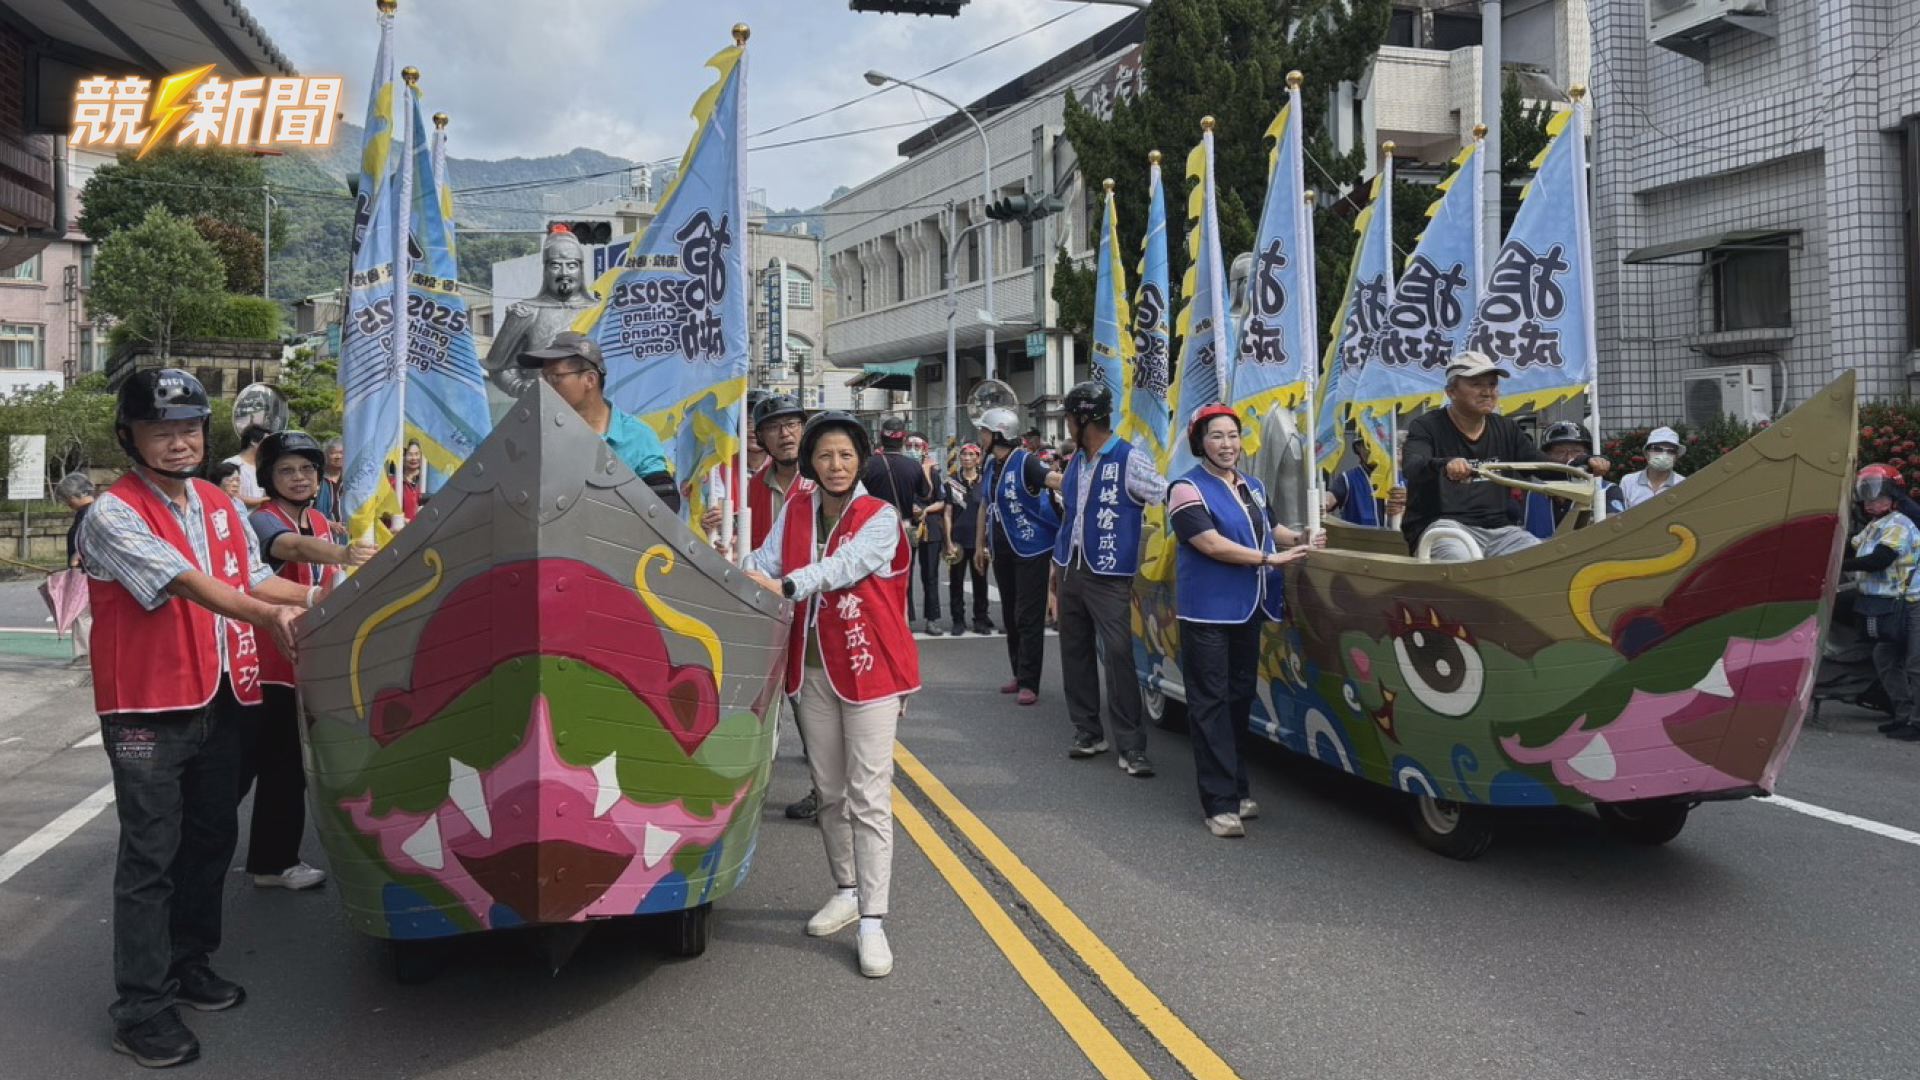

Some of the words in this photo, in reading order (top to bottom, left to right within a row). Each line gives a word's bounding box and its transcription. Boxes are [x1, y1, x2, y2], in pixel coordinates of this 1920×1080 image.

[408, 318, 449, 346] hiang
[408, 336, 446, 362] heng
[406, 354, 430, 372] ong
